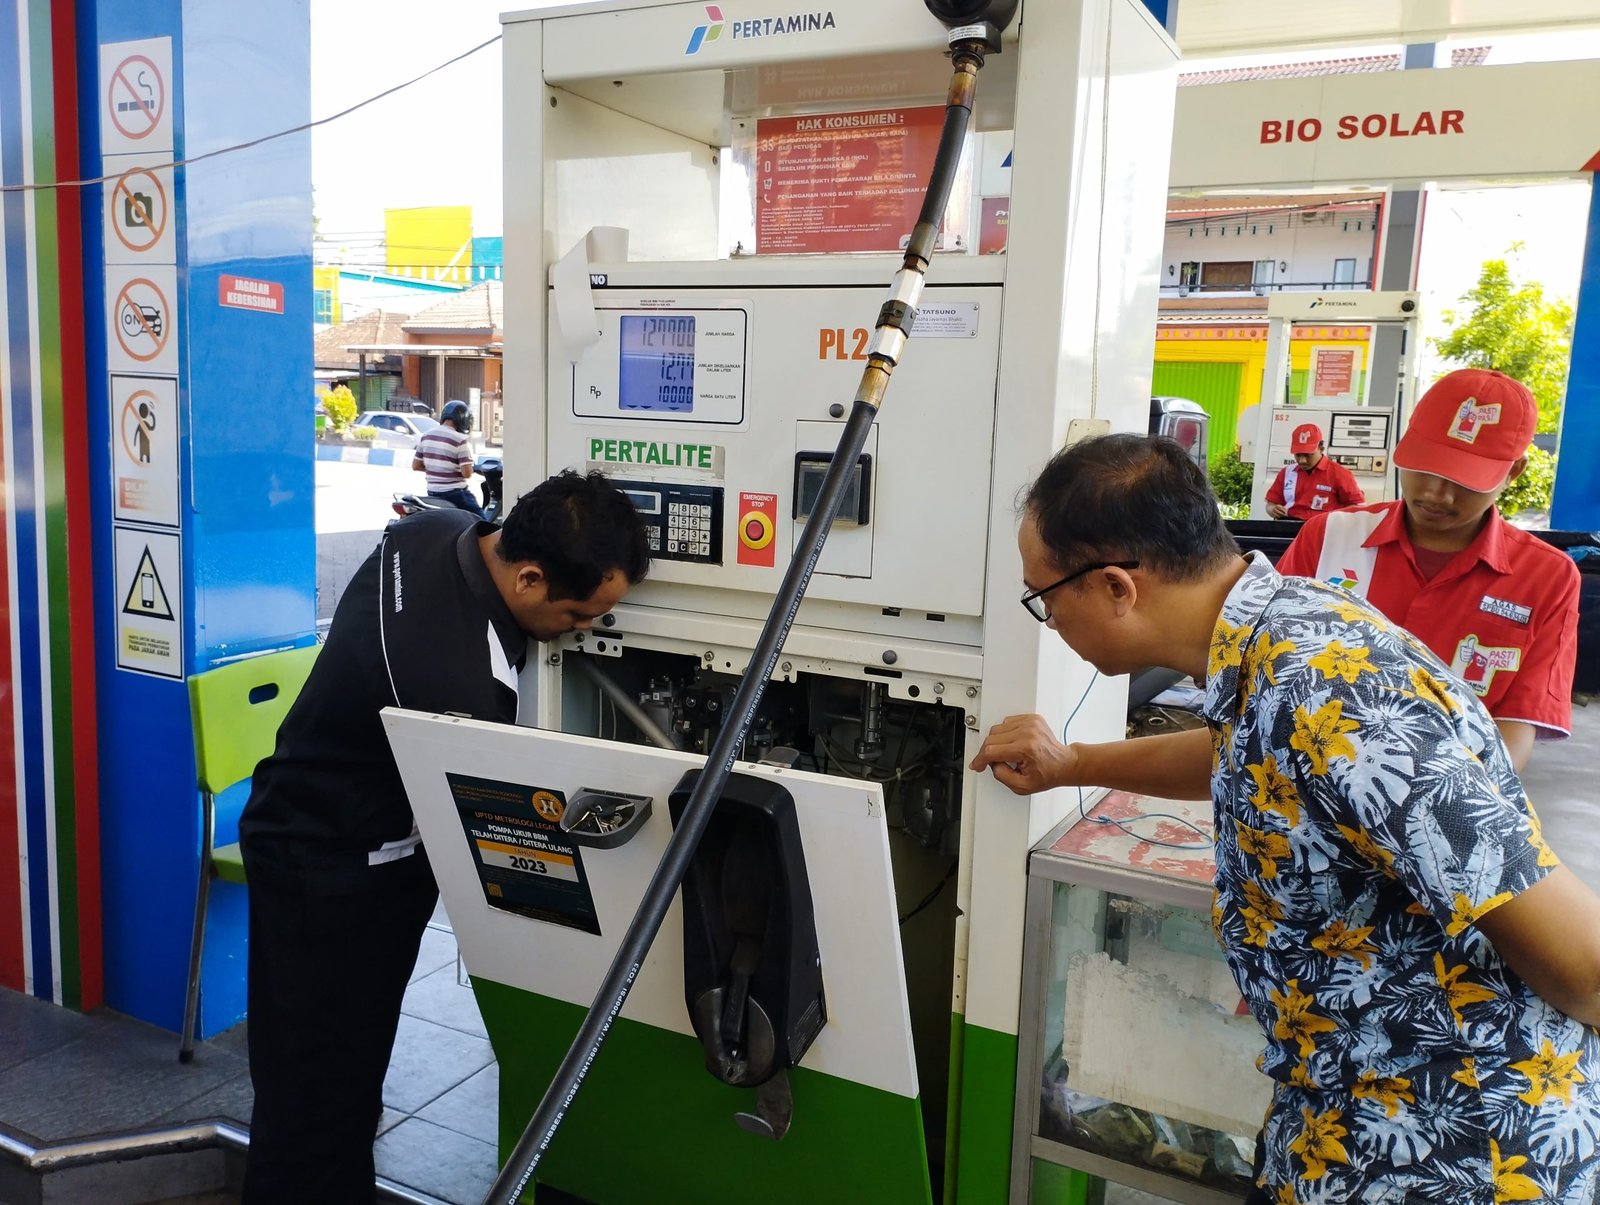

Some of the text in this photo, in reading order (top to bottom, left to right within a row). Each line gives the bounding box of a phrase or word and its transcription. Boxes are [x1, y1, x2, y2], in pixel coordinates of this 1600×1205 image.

[733, 12, 835, 39] PERTAMINA
[796, 119, 821, 131] HAK
[826, 113, 896, 129] KONSUMEN
[1260, 109, 1464, 144] BIO SOLAR
[234, 279, 270, 295] JAGALAH
[227, 291, 277, 310] KEBERSIHAN
[590, 385, 602, 399] Rp
[658, 385, 694, 404] 10000
[590, 438, 712, 469] PERTALITE
[743, 493, 773, 502] EMERGENCY
[751, 500, 765, 508] STOP
[1492, 599, 1516, 611] AGAS
[1489, 650, 1516, 660] PASTI
[736, 729, 747, 747] FUEL
[745, 684, 765, 725] DISPENSER
[763, 652, 779, 682] RUBBER
[777, 628, 788, 650] HOSE
[474, 811, 557, 832] UPTD METROLOGI LEGAL
[470, 829, 493, 840] TELAH
[494, 833, 518, 844] DITERA
[522, 838, 548, 850] DITERA
[547, 844, 573, 855] ULANG
[487, 824, 549, 841] POMPA UKUR BBM
[513, 847, 537, 858] TAHUN
[508, 855, 548, 874] 2023
[508, 1153, 541, 1205] DISPENSER
[540, 1111, 564, 1150] RUBBER
[562, 1082, 580, 1108] HOSE
[611, 987, 628, 1016] 900PSI
